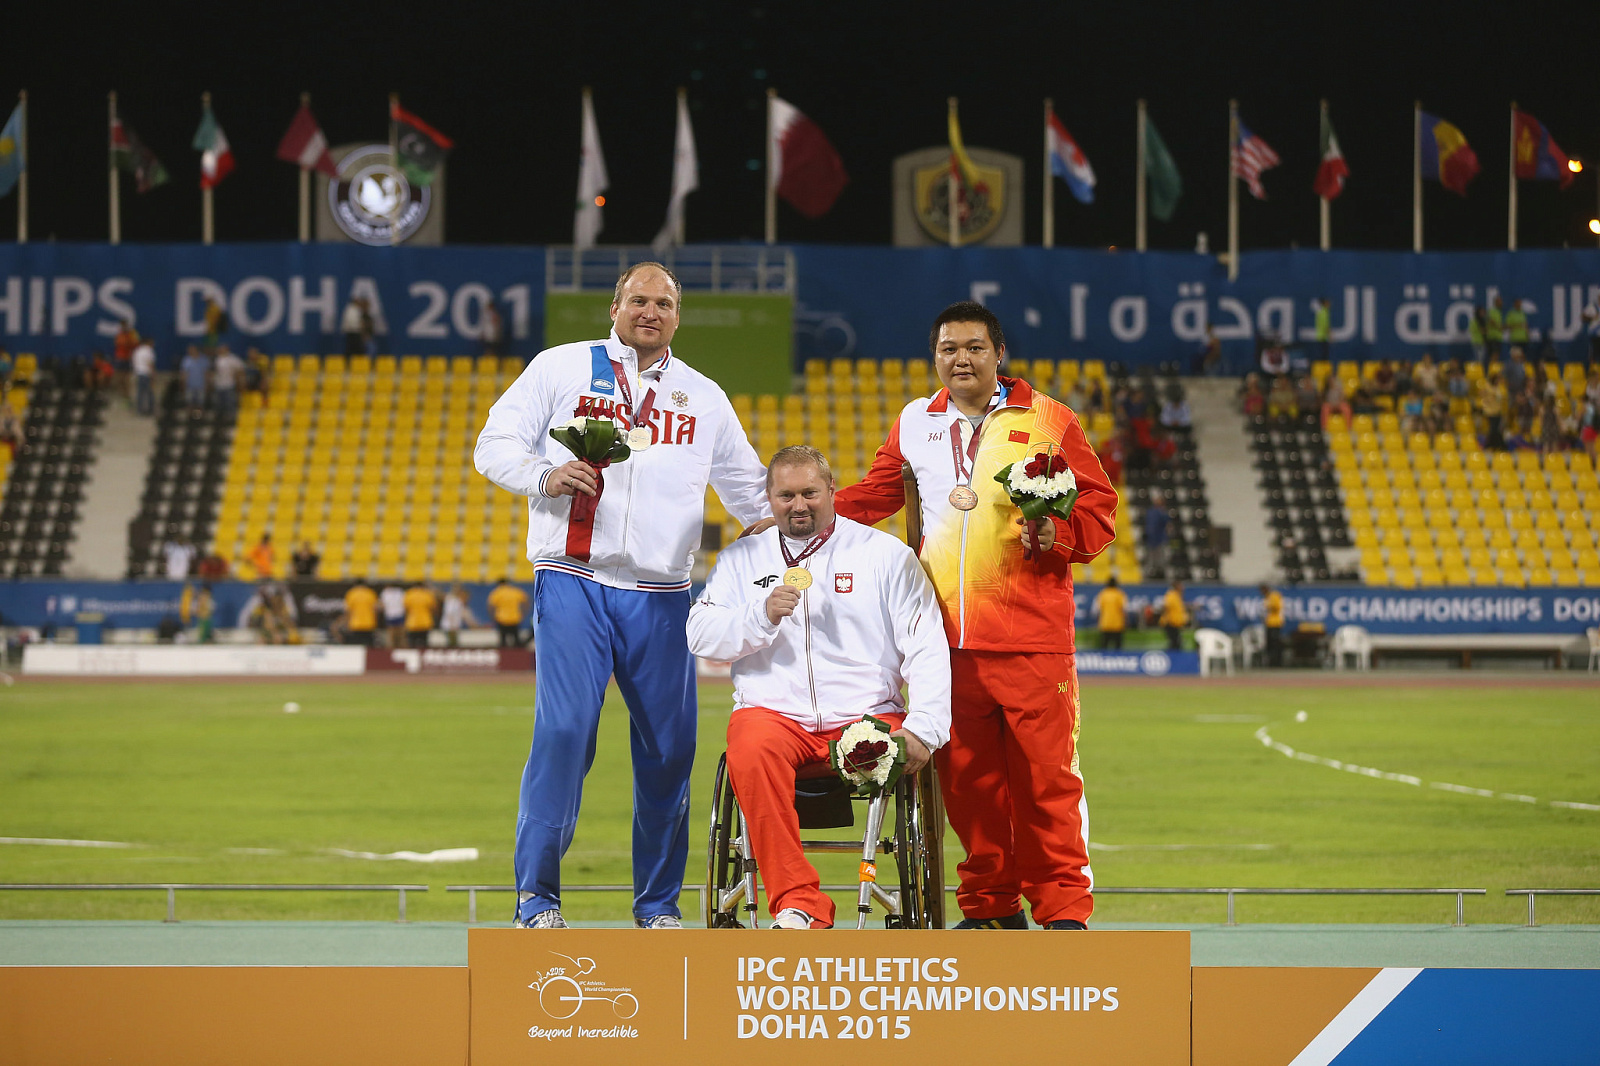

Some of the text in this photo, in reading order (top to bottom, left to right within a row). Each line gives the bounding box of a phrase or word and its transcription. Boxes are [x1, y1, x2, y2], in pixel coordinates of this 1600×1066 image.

[175, 277, 386, 336] DOHA
[753, 574, 779, 588] 4F
[1234, 596, 1329, 621] WRLD
[1332, 597, 1542, 622] CHAMPIONSHIPS
[1075, 652, 1139, 671] llianz
[737, 957, 959, 983] IPC ATHLETICS
[737, 985, 1119, 1011] WORLD CHAMPIONSHIPS
[527, 1024, 639, 1042] Beyond Incredible
[737, 1014, 911, 1040] DOHA 2015
